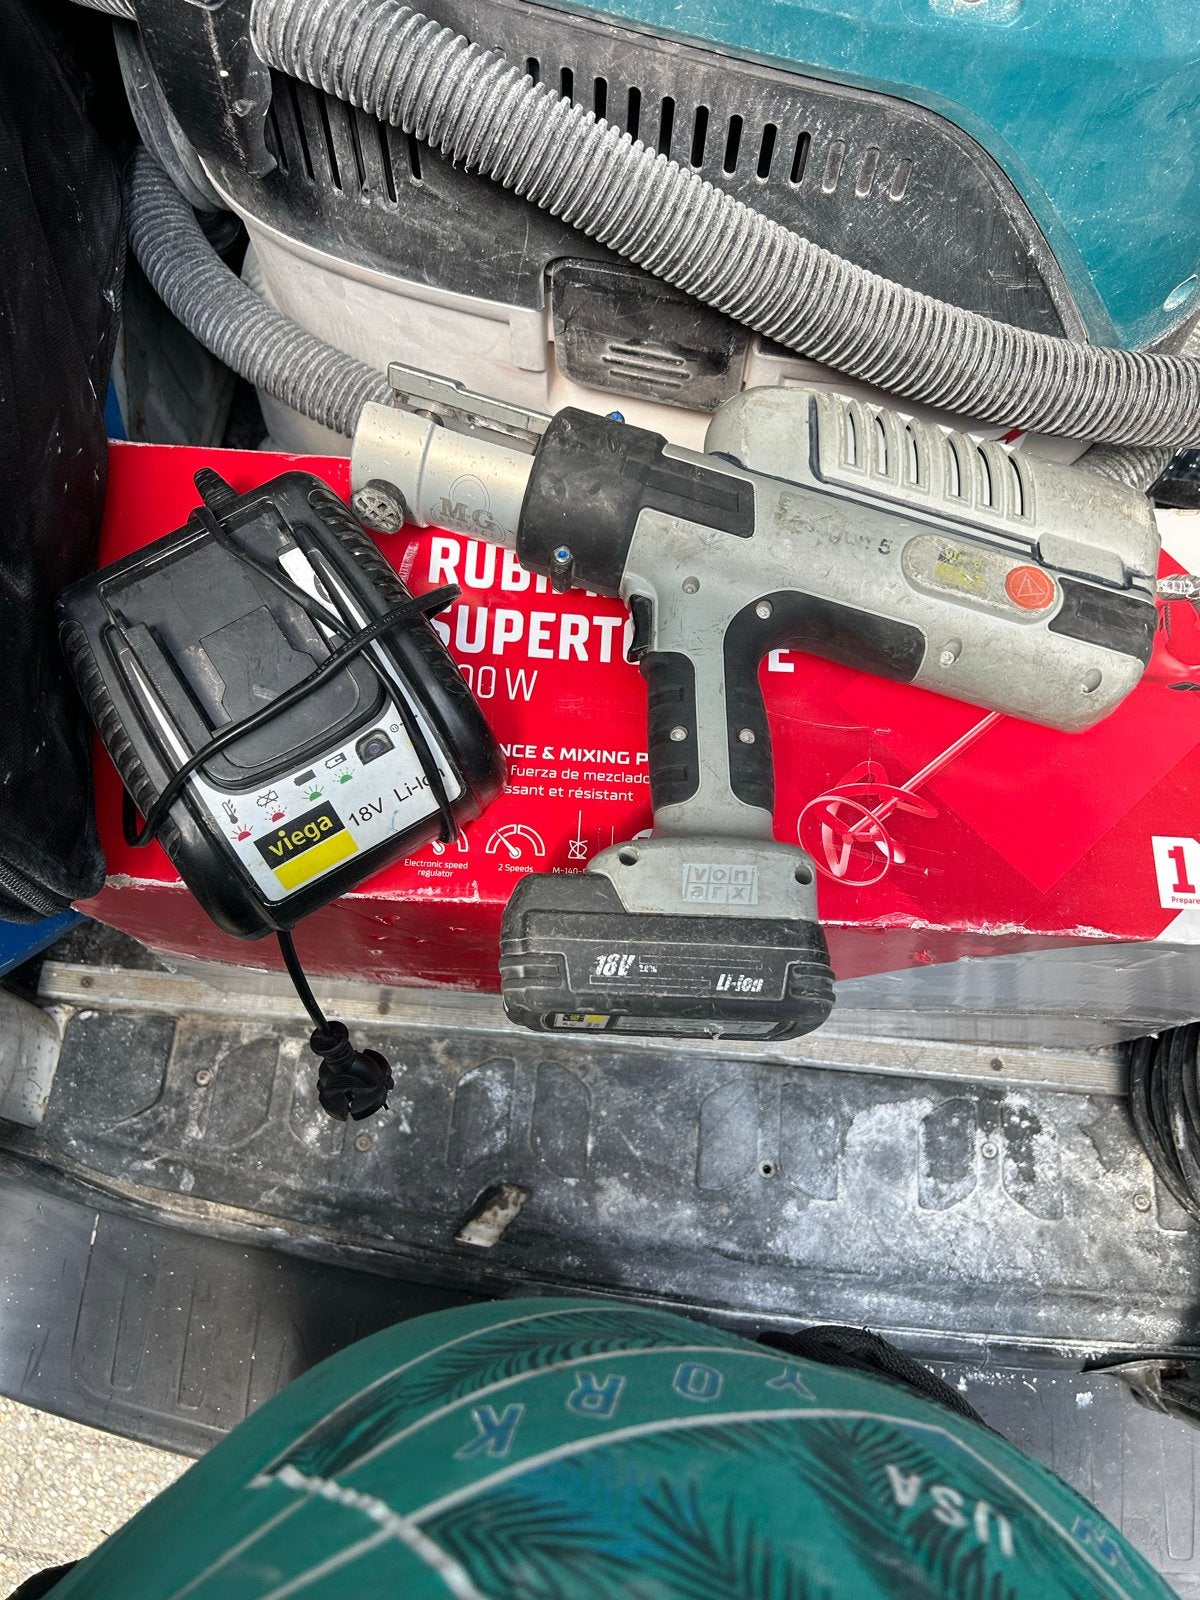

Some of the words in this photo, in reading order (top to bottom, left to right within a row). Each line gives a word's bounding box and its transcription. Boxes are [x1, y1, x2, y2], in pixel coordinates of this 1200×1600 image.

[505, 667, 539, 702] W
[542, 746, 556, 760] &
[559, 747, 631, 765] MIXING
[510, 764, 558, 779] fuerza
[561, 768, 580, 780] de
[548, 786, 565, 798] et
[568, 786, 635, 802] résistant
[347, 797, 384, 828] 18V
[267, 813, 335, 858] viega
[403, 858, 443, 868] Electronic
[444, 861, 469, 871] speed
[417, 868, 455, 878] regulator
[497, 863, 504, 872] 2
[504, 864, 535, 873] Speeds
[693, 866, 750, 884] von
[690, 885, 748, 900] arx
[885, 1463, 1015, 1559] USA
